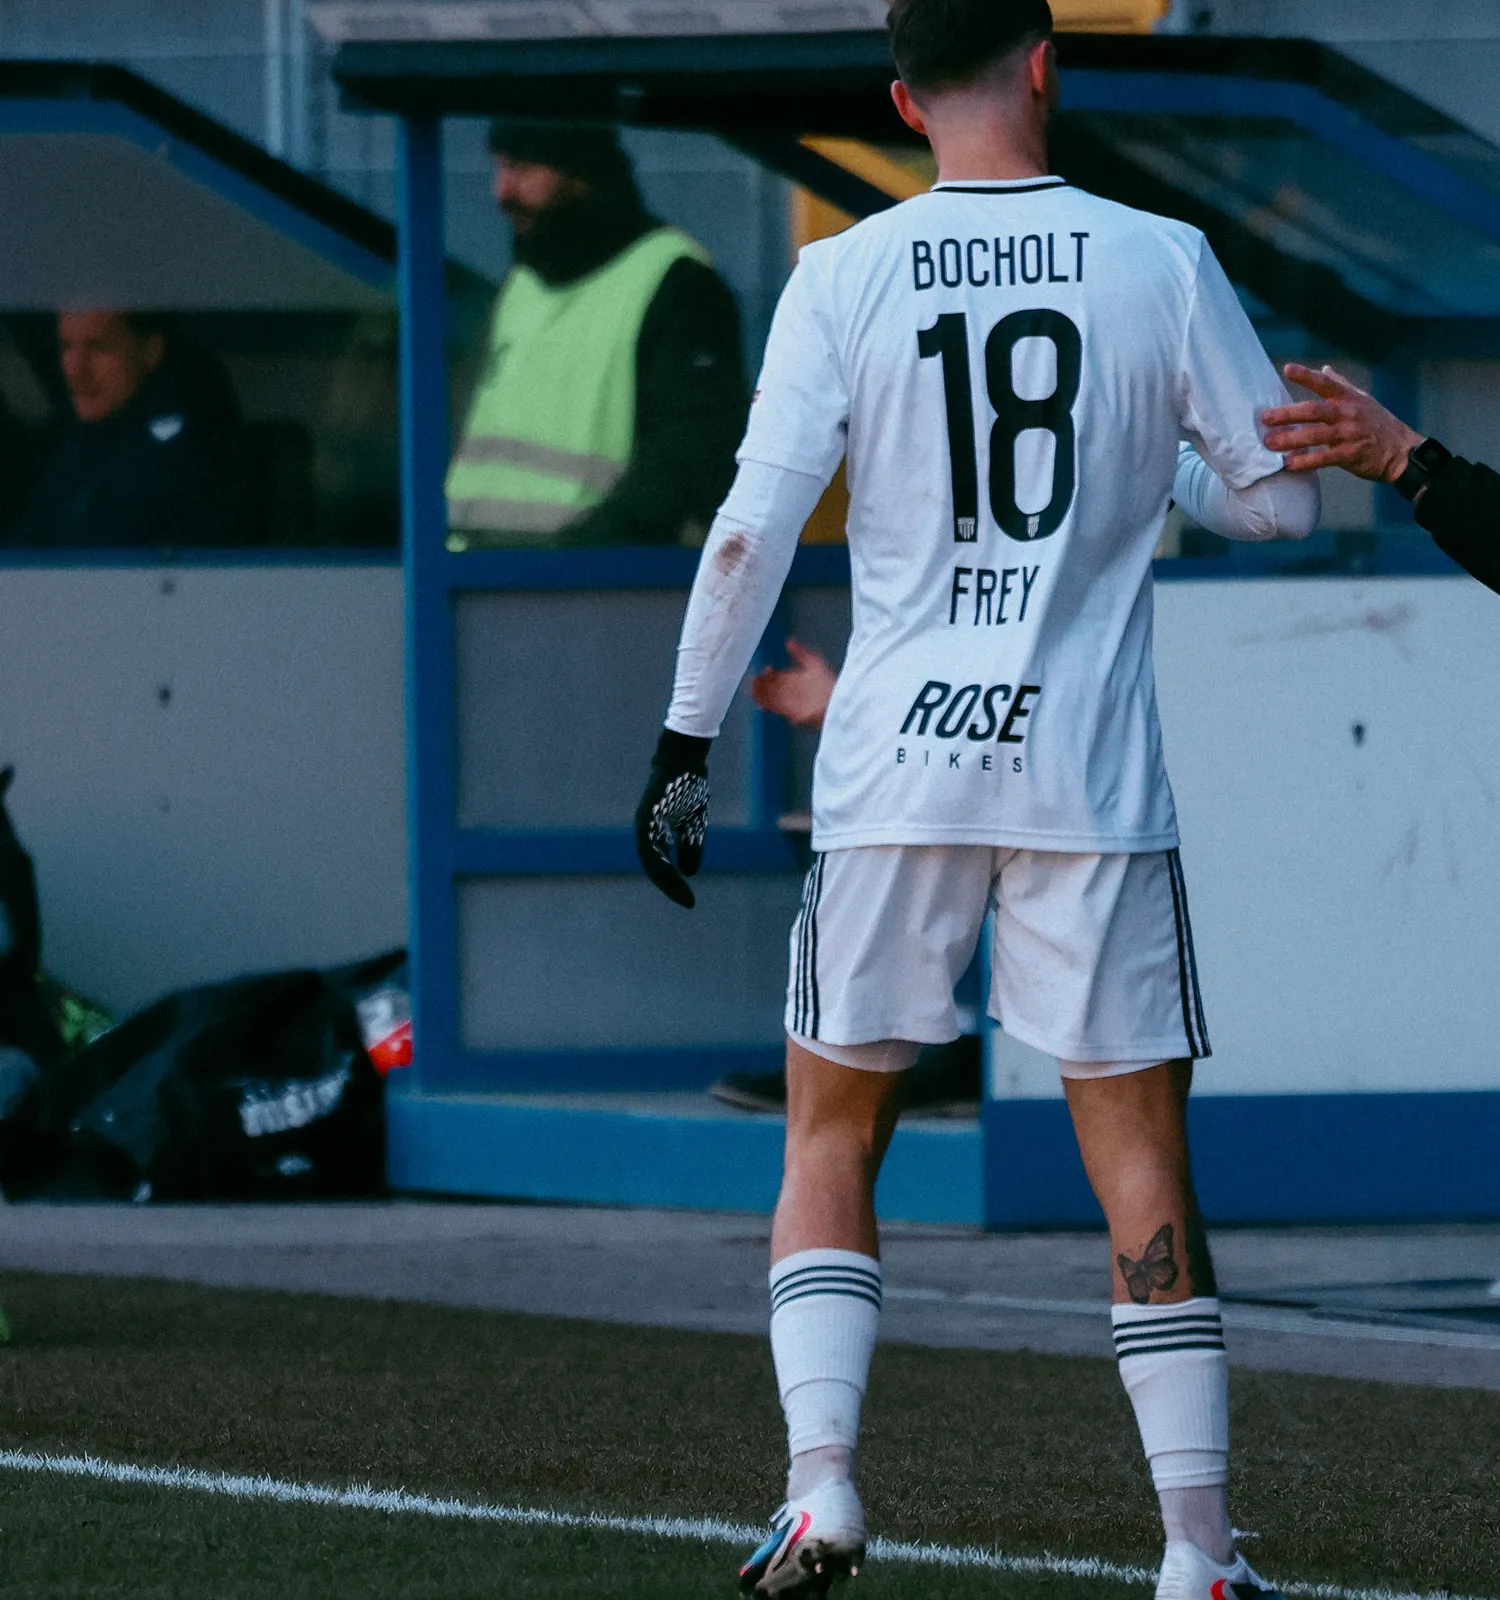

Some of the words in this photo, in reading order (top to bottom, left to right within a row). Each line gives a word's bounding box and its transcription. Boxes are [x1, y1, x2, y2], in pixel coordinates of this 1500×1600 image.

[912, 232, 1090, 291] BOCHOLT
[917, 308, 1083, 543] 18
[949, 565, 1040, 626] FREY
[899, 680, 1042, 744] ROSE
[896, 747, 1024, 774] BIKES
